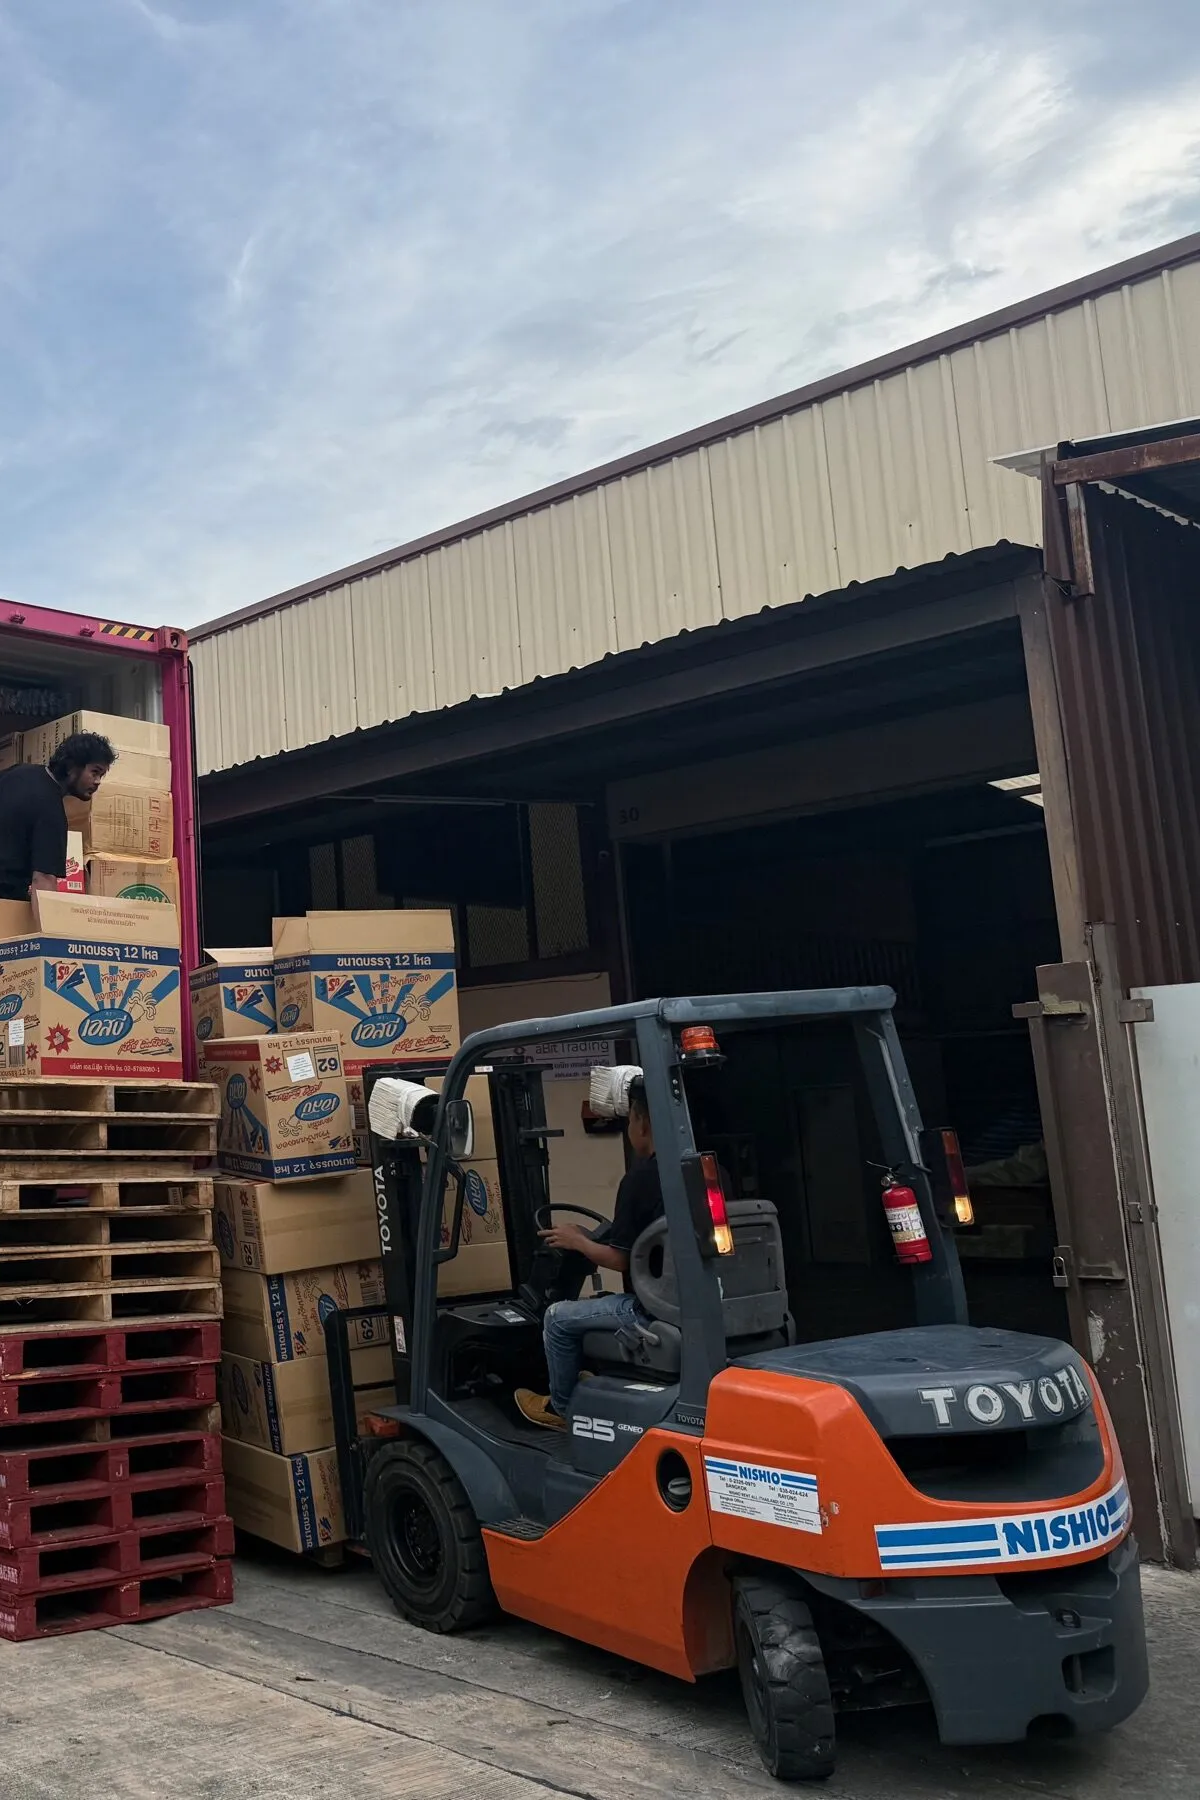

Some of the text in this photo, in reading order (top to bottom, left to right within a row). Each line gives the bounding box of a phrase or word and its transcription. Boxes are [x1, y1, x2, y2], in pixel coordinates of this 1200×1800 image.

[20, 944, 28, 952] 12
[124, 947, 138, 958] 12
[142, 947, 159, 961] โหล
[395, 955, 410, 966] 12
[413, 954, 432, 966] โหล
[282, 1040, 292, 1048] 12
[318, 1058, 338, 1072] 62
[274, 1164, 290, 1174] โหล
[294, 1164, 306, 1172] 12
[374, 1165, 392, 1255] TOYOTA
[244, 1244, 252, 1266] 62
[272, 1293, 280, 1306] 12
[362, 1319, 373, 1340] 62
[918, 1364, 1090, 1427] TOYOTA
[676, 1414, 704, 1426] TOYOTA
[573, 1415, 644, 1442] 25 GENEO
[738, 1466, 780, 1484] NISHIO
[298, 1480, 306, 1494] 12
[1002, 1502, 1110, 1555] NISHIO
